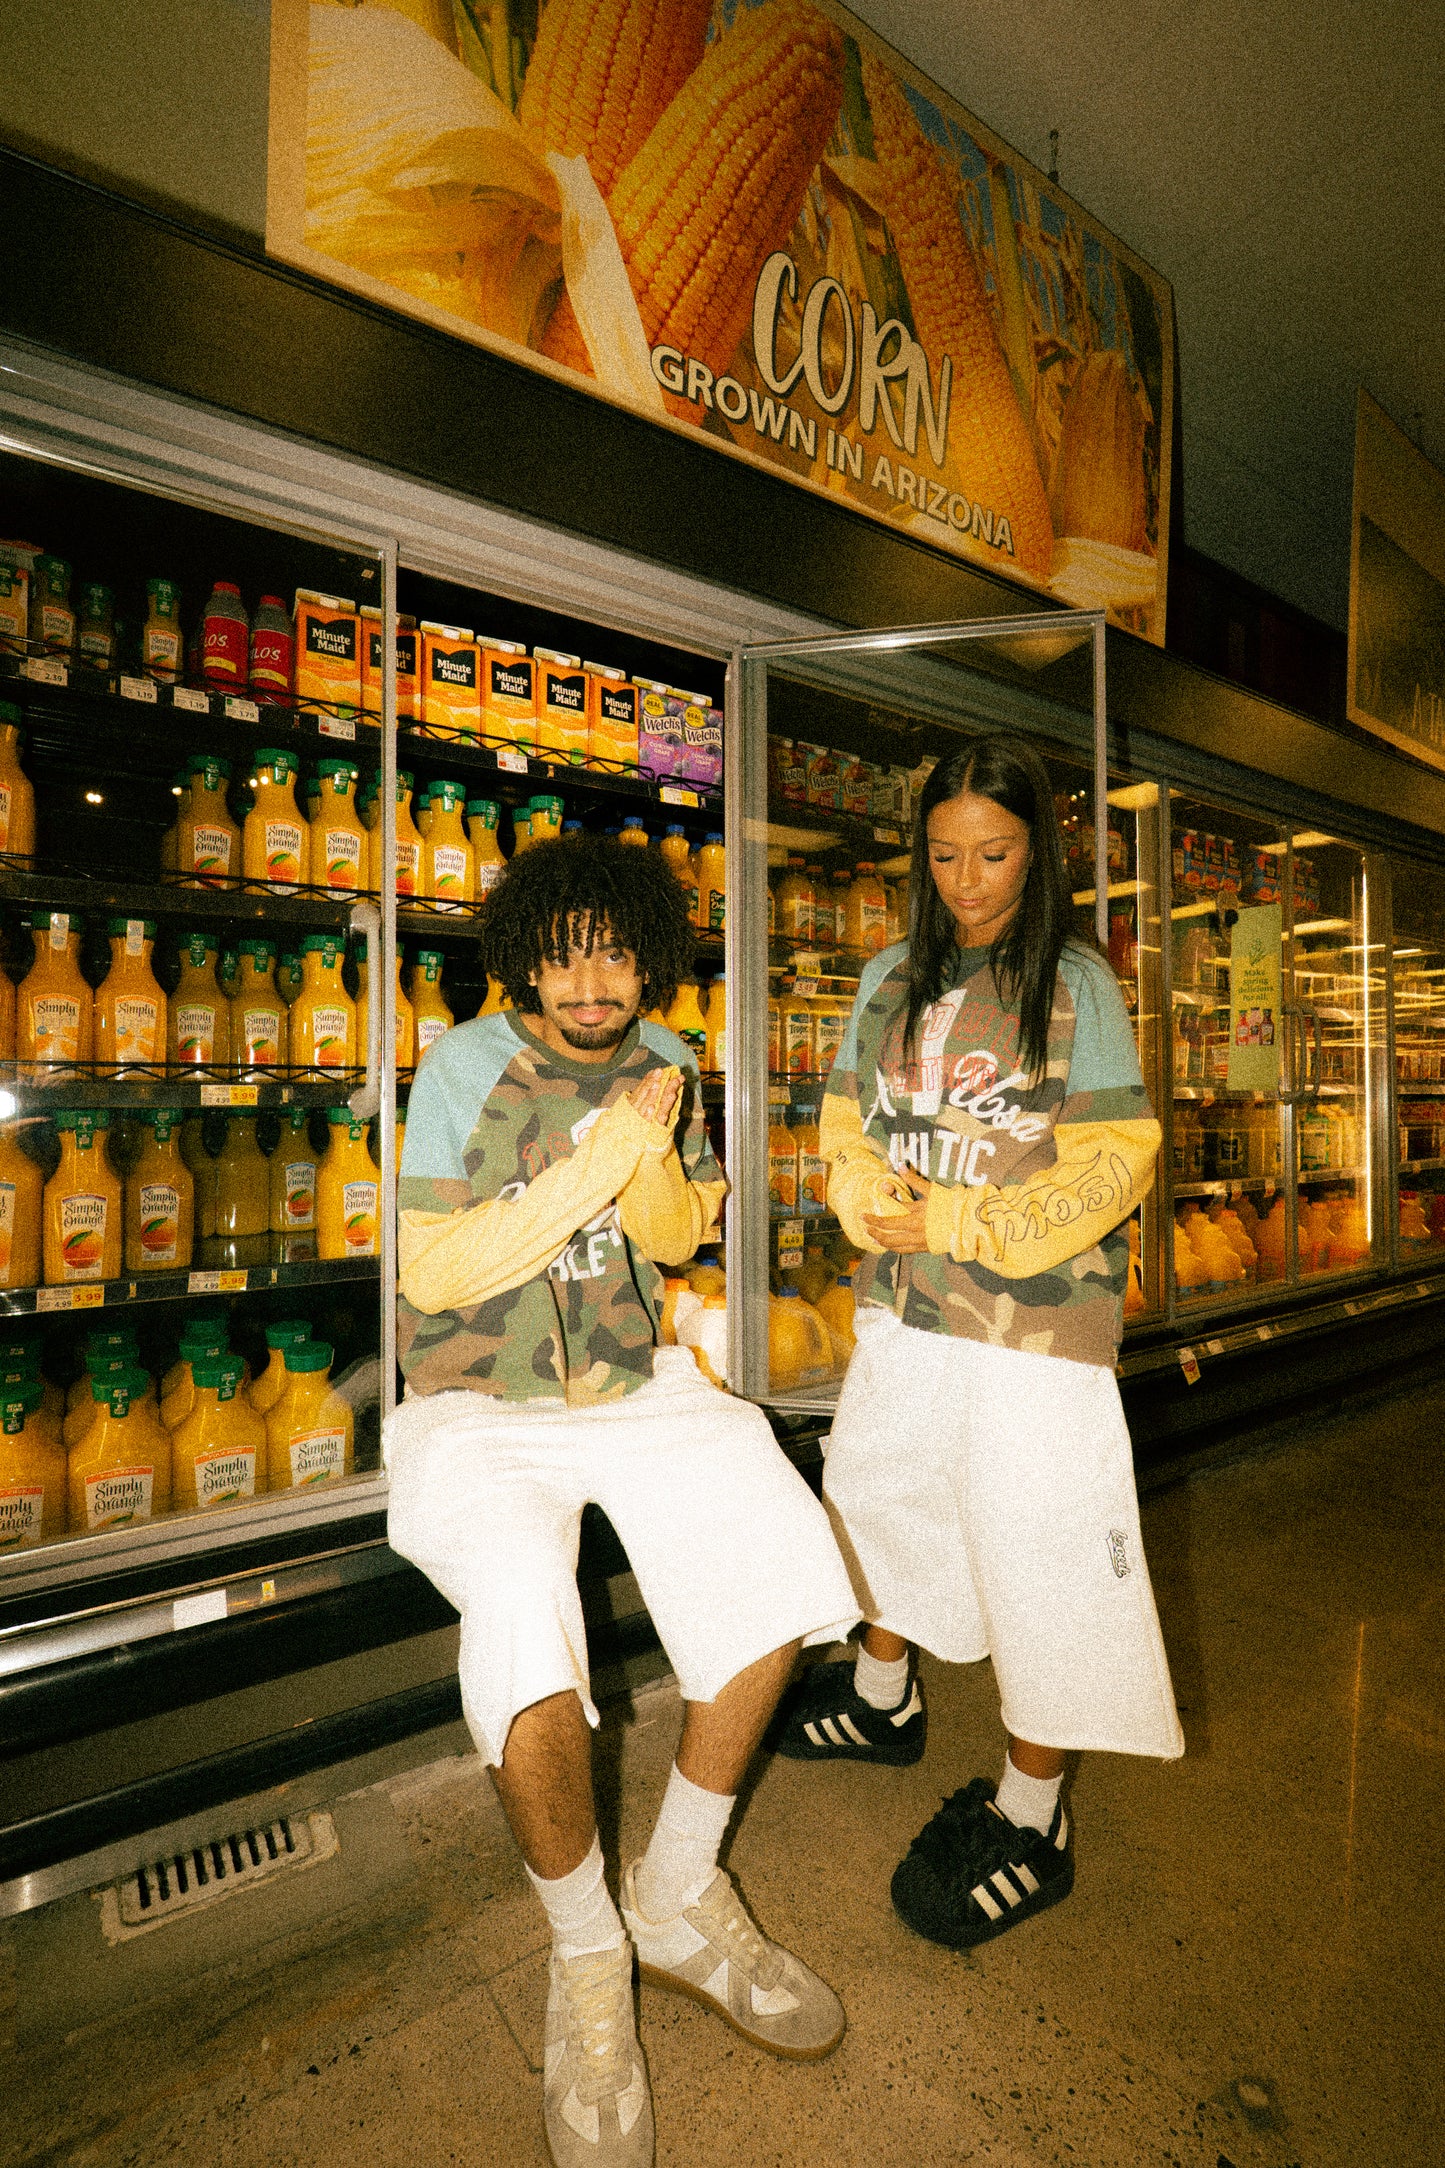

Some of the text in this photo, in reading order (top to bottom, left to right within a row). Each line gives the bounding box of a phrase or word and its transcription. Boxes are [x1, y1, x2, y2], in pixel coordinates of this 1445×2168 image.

[752, 250, 953, 468] CORN
[650, 345, 1015, 556] GROWN IN ARIZONA
[312, 627, 351, 646] Minute
[317, 638, 346, 655] Maid
[437, 658, 472, 675] Minute
[441, 670, 467, 684] Maid
[495, 670, 529, 687] Minute
[500, 682, 524, 695] Maid
[551, 683, 582, 699] Minute
[555, 694, 578, 707] Maid
[604, 696, 633, 711] Minute
[608, 707, 629, 719] Maid
[645, 717, 681, 732] Welch's
[686, 727, 721, 742] Welch's
[196, 831, 229, 845] Simply
[268, 825, 300, 841] Simply
[195, 842, 229, 854] Orange
[267, 838, 300, 850] Orange
[327, 834, 358, 848] Simply
[327, 845, 358, 857] Orange
[435, 849, 465, 863] Simply
[37, 1000, 76, 1016] Simply
[117, 1002, 155, 1018] Simply
[179, 1011, 211, 1024] Simply
[246, 1015, 276, 1029] Simply
[315, 1012, 345, 1024] Simply
[178, 1022, 212, 1034] Orange
[315, 1022, 345, 1033] Orange
[233, 1092, 255, 1100] 3.99
[288, 1168, 313, 1181] Simply
[143, 1192, 178, 1205] Simply
[346, 1188, 375, 1202] Simply
[64, 1203, 104, 1216] Simply
[142, 1203, 177, 1216] Orange
[345, 1200, 375, 1212] Orange
[64, 1215, 103, 1228] Orange
[221, 1276, 245, 1286] 3.99
[54, 1293, 102, 1308] 4.99 3.99
[298, 1439, 337, 1457] Simply
[204, 1458, 248, 1476] Simply
[297, 1453, 337, 1472] Orange
[95, 1478, 144, 1500] Simply
[203, 1471, 248, 1494] Orange
[94, 1494, 143, 1516] Orange
